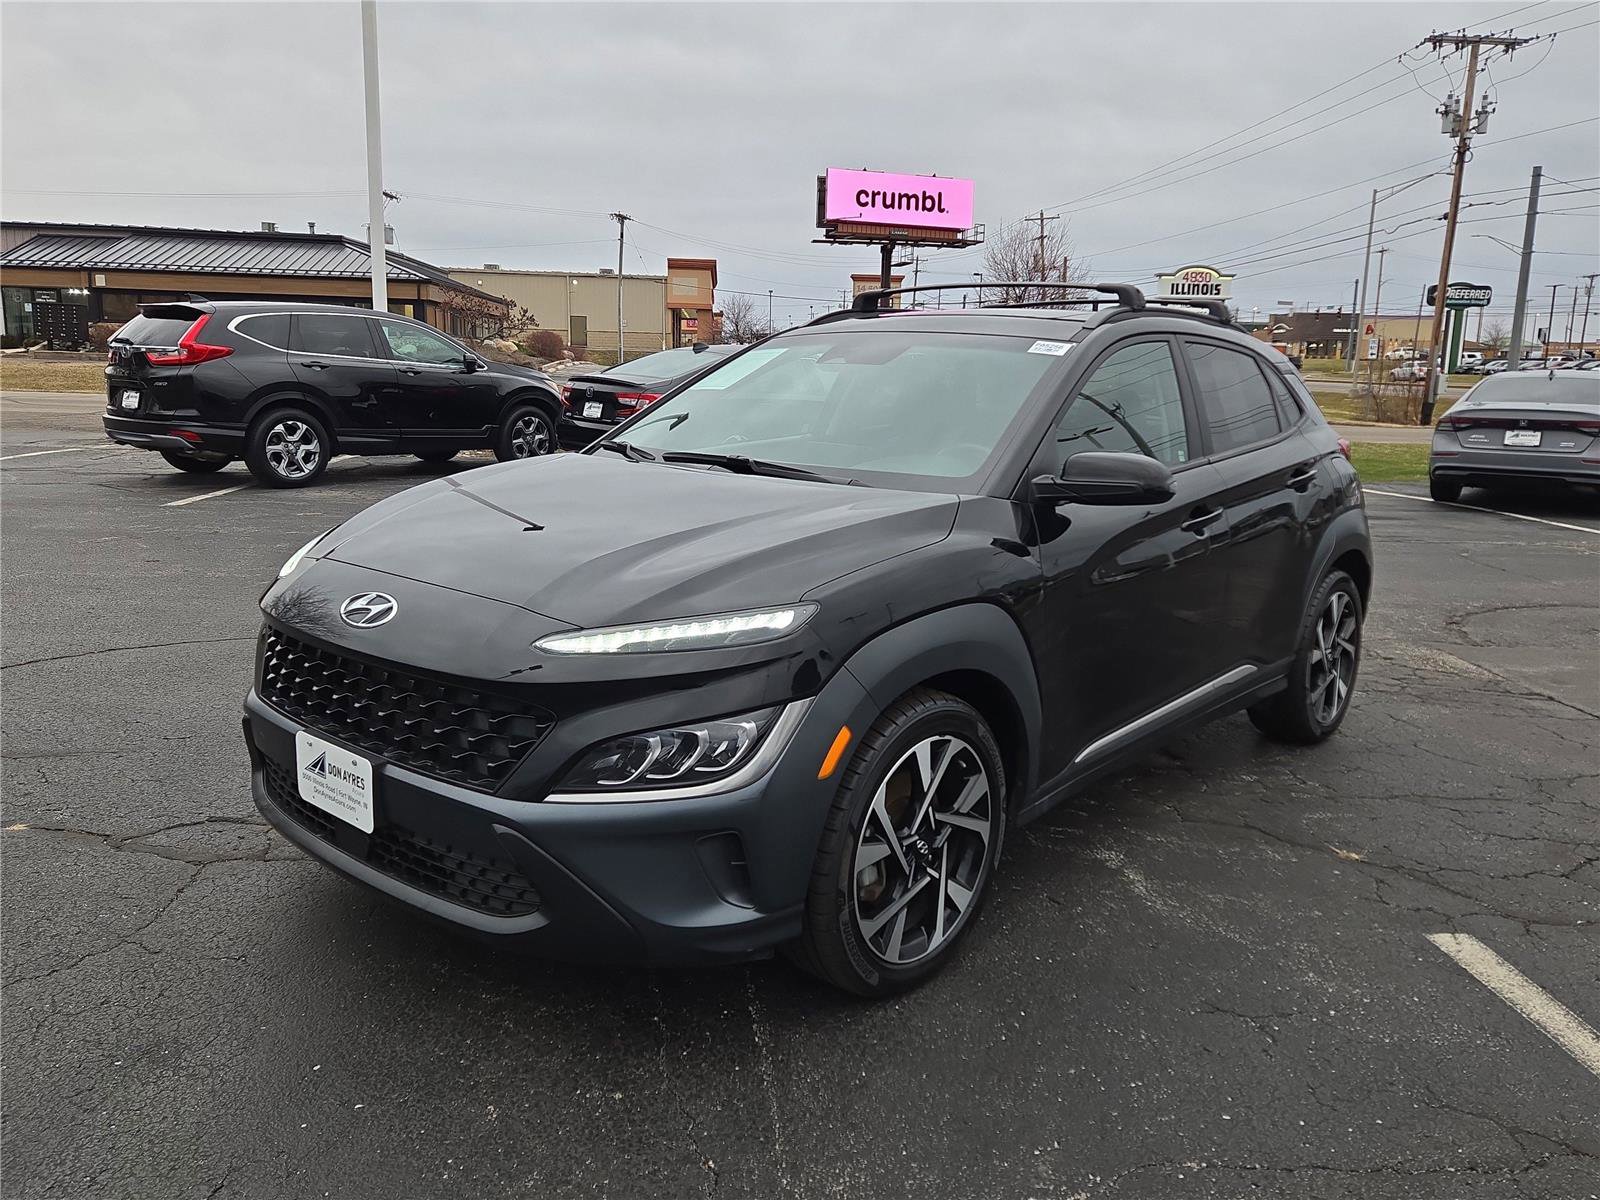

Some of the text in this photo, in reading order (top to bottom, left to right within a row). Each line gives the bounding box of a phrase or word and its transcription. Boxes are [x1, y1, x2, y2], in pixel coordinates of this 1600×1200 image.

[1182, 271, 1212, 283] 4930
[1170, 282, 1222, 296] ILLINOIS
[327, 762, 365, 791] DON AYRES
